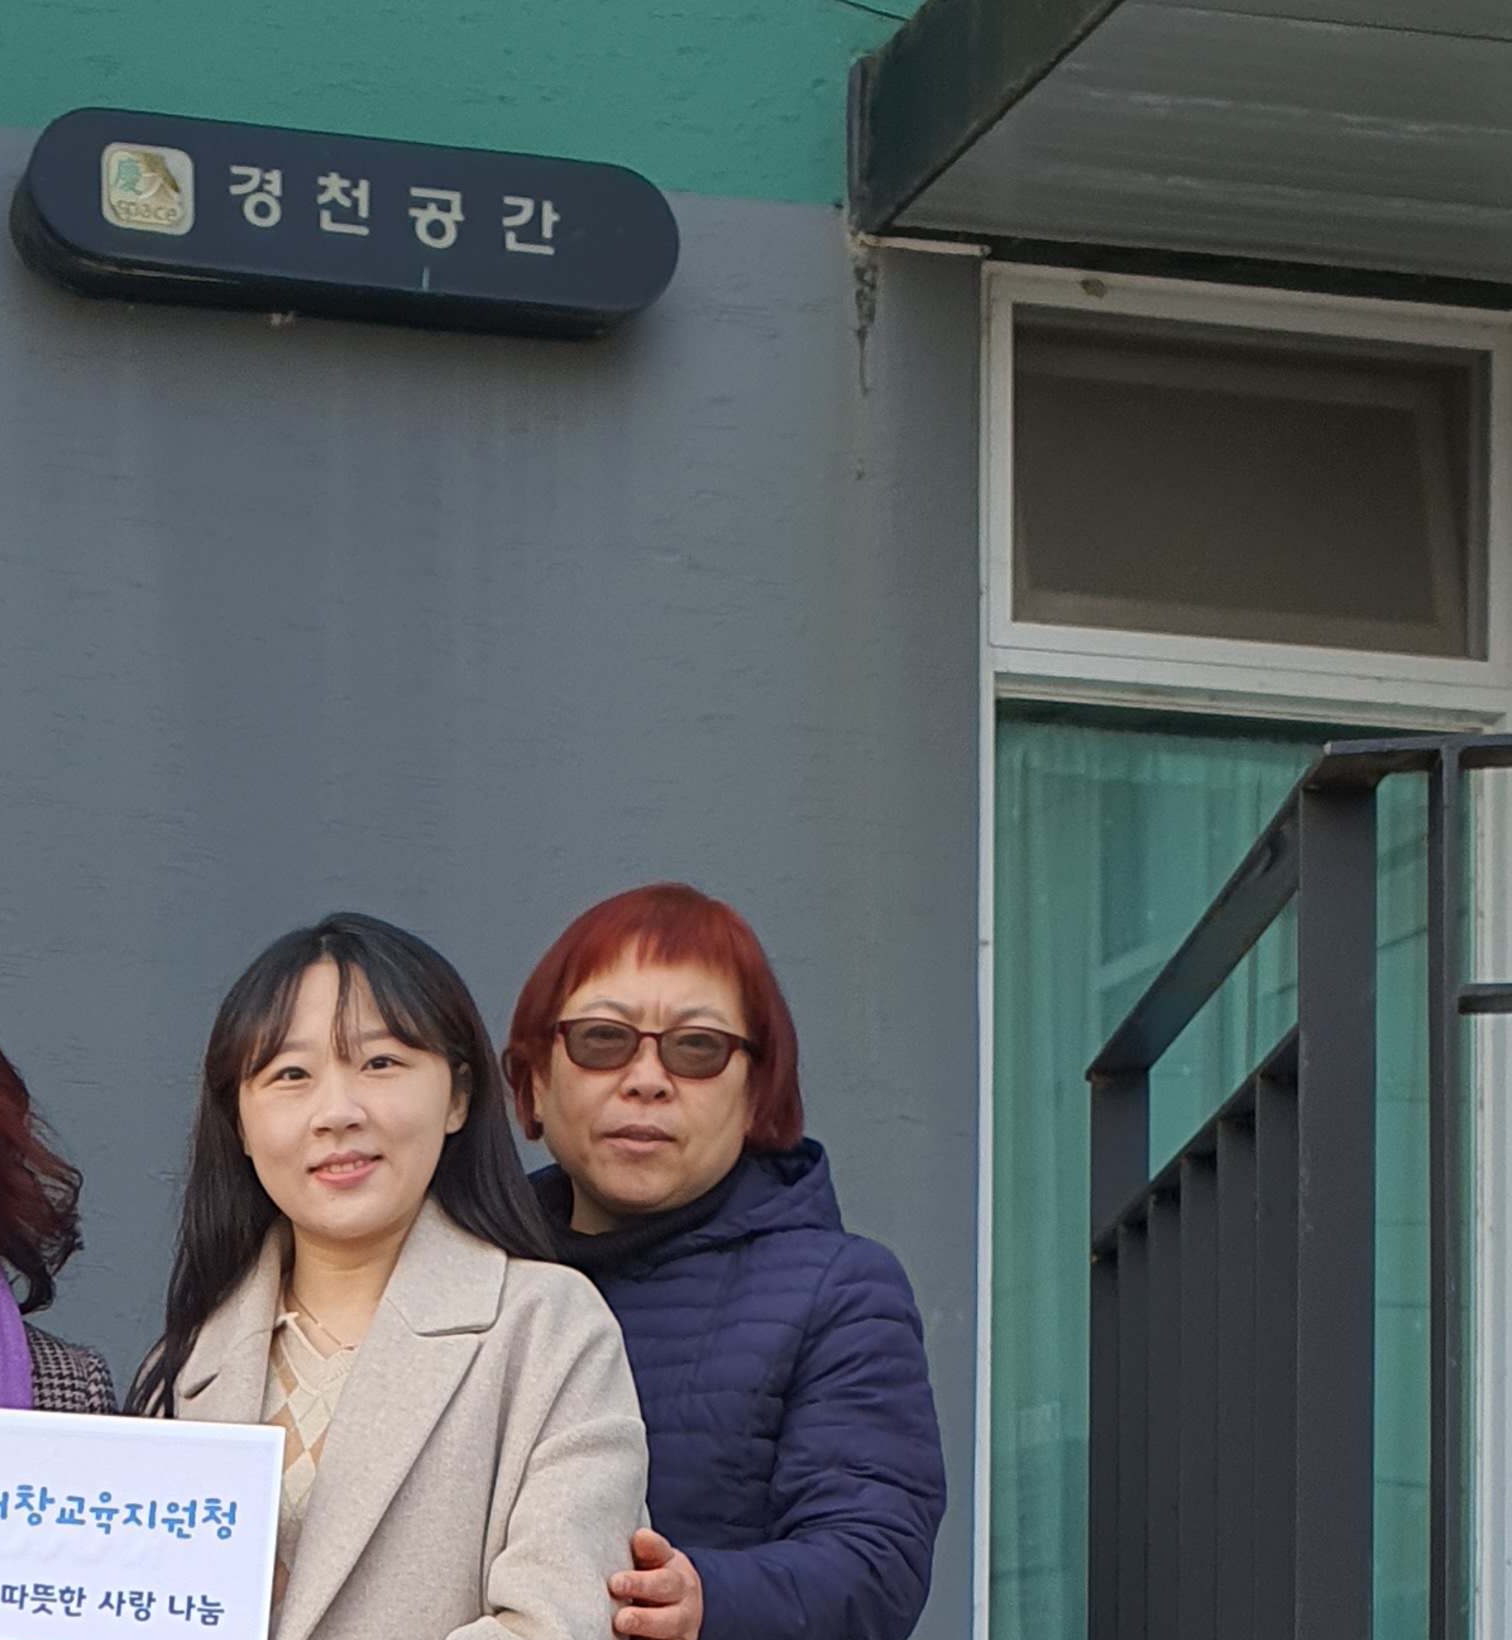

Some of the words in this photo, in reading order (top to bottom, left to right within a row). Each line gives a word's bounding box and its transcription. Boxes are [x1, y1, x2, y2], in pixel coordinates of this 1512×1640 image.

[229, 163, 561, 256] 경천공간
[1, 1584, 88, 1618] 따뜻한
[98, 1590, 157, 1623] 사랑
[168, 1595, 226, 1627] 나눔
